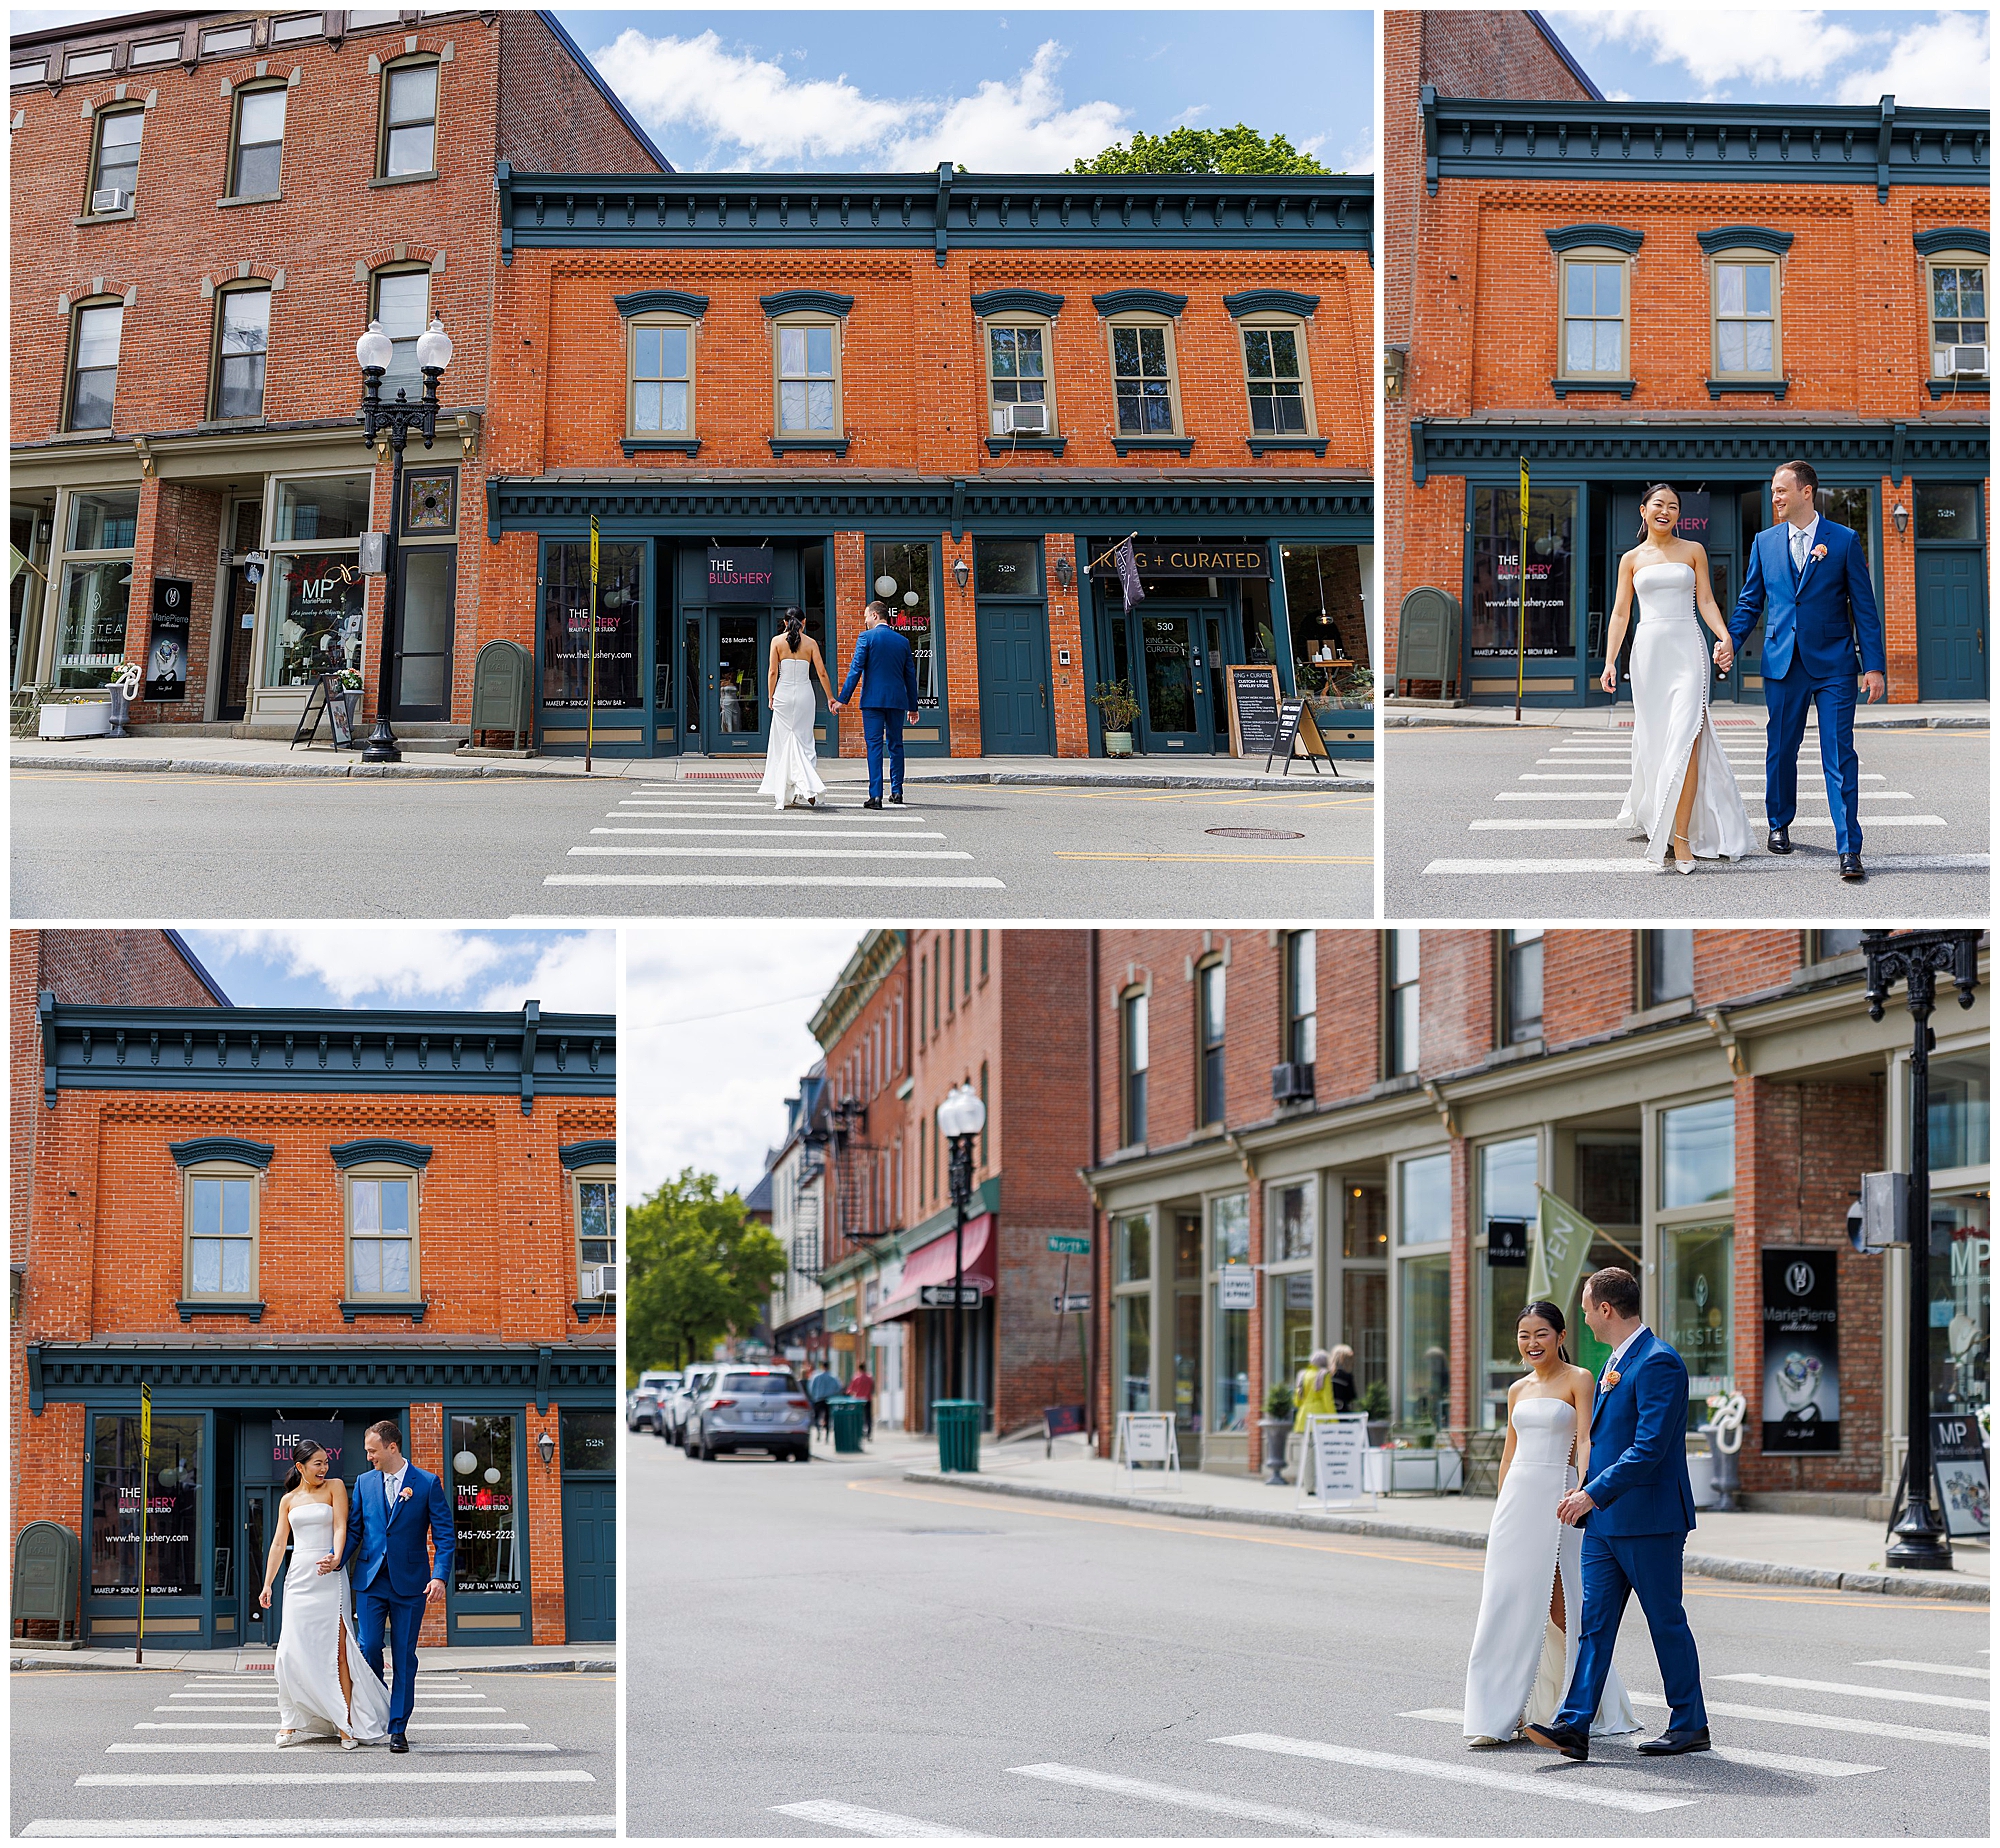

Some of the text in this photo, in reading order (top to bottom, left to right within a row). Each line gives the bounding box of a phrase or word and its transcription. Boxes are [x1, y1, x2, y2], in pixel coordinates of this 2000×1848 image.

[1937, 509, 1956, 517] 528
[1675, 518, 1709, 530] HERY
[710, 560, 734, 571] THE
[1100, 552, 1148, 568] KIG
[1170, 553, 1261, 568] CURATED
[1498, 555, 1519, 565] THE
[998, 564, 1016, 572] 528
[709, 572, 772, 584] BLUSHERY
[302, 579, 334, 599] MP
[1484, 597, 1564, 608] www.theushery.com
[152, 612, 189, 623] MariePierre
[569, 608, 589, 618] THE
[64, 623, 123, 635] MISSTEA
[1156, 622, 1174, 631] 530
[556, 650, 632, 660] www.theushery.com
[911, 649, 933, 658] -2223
[1489, 1248, 1526, 1257] MISSTEA
[1546, 1216, 1575, 1279] PEN
[1950, 1239, 1990, 1277] MP
[1763, 1306, 1836, 1322] MariePierre
[1780, 1321, 1818, 1332] collection
[1938, 1422, 1967, 1445] MP
[274, 1434, 300, 1447] THE
[585, 1438, 605, 1447] 528
[273, 1447, 343, 1460] BLRY
[1934, 1446, 1954, 1458] ewelry
[120, 1487, 141, 1498] THE
[457, 1485, 478, 1496] THE
[118, 1497, 176, 1508] BLUHERY
[457, 1494, 513, 1505] BLUHERY
[105, 1532, 189, 1543] www.theushery.com
[457, 1530, 515, 1540] 845-765-2223
